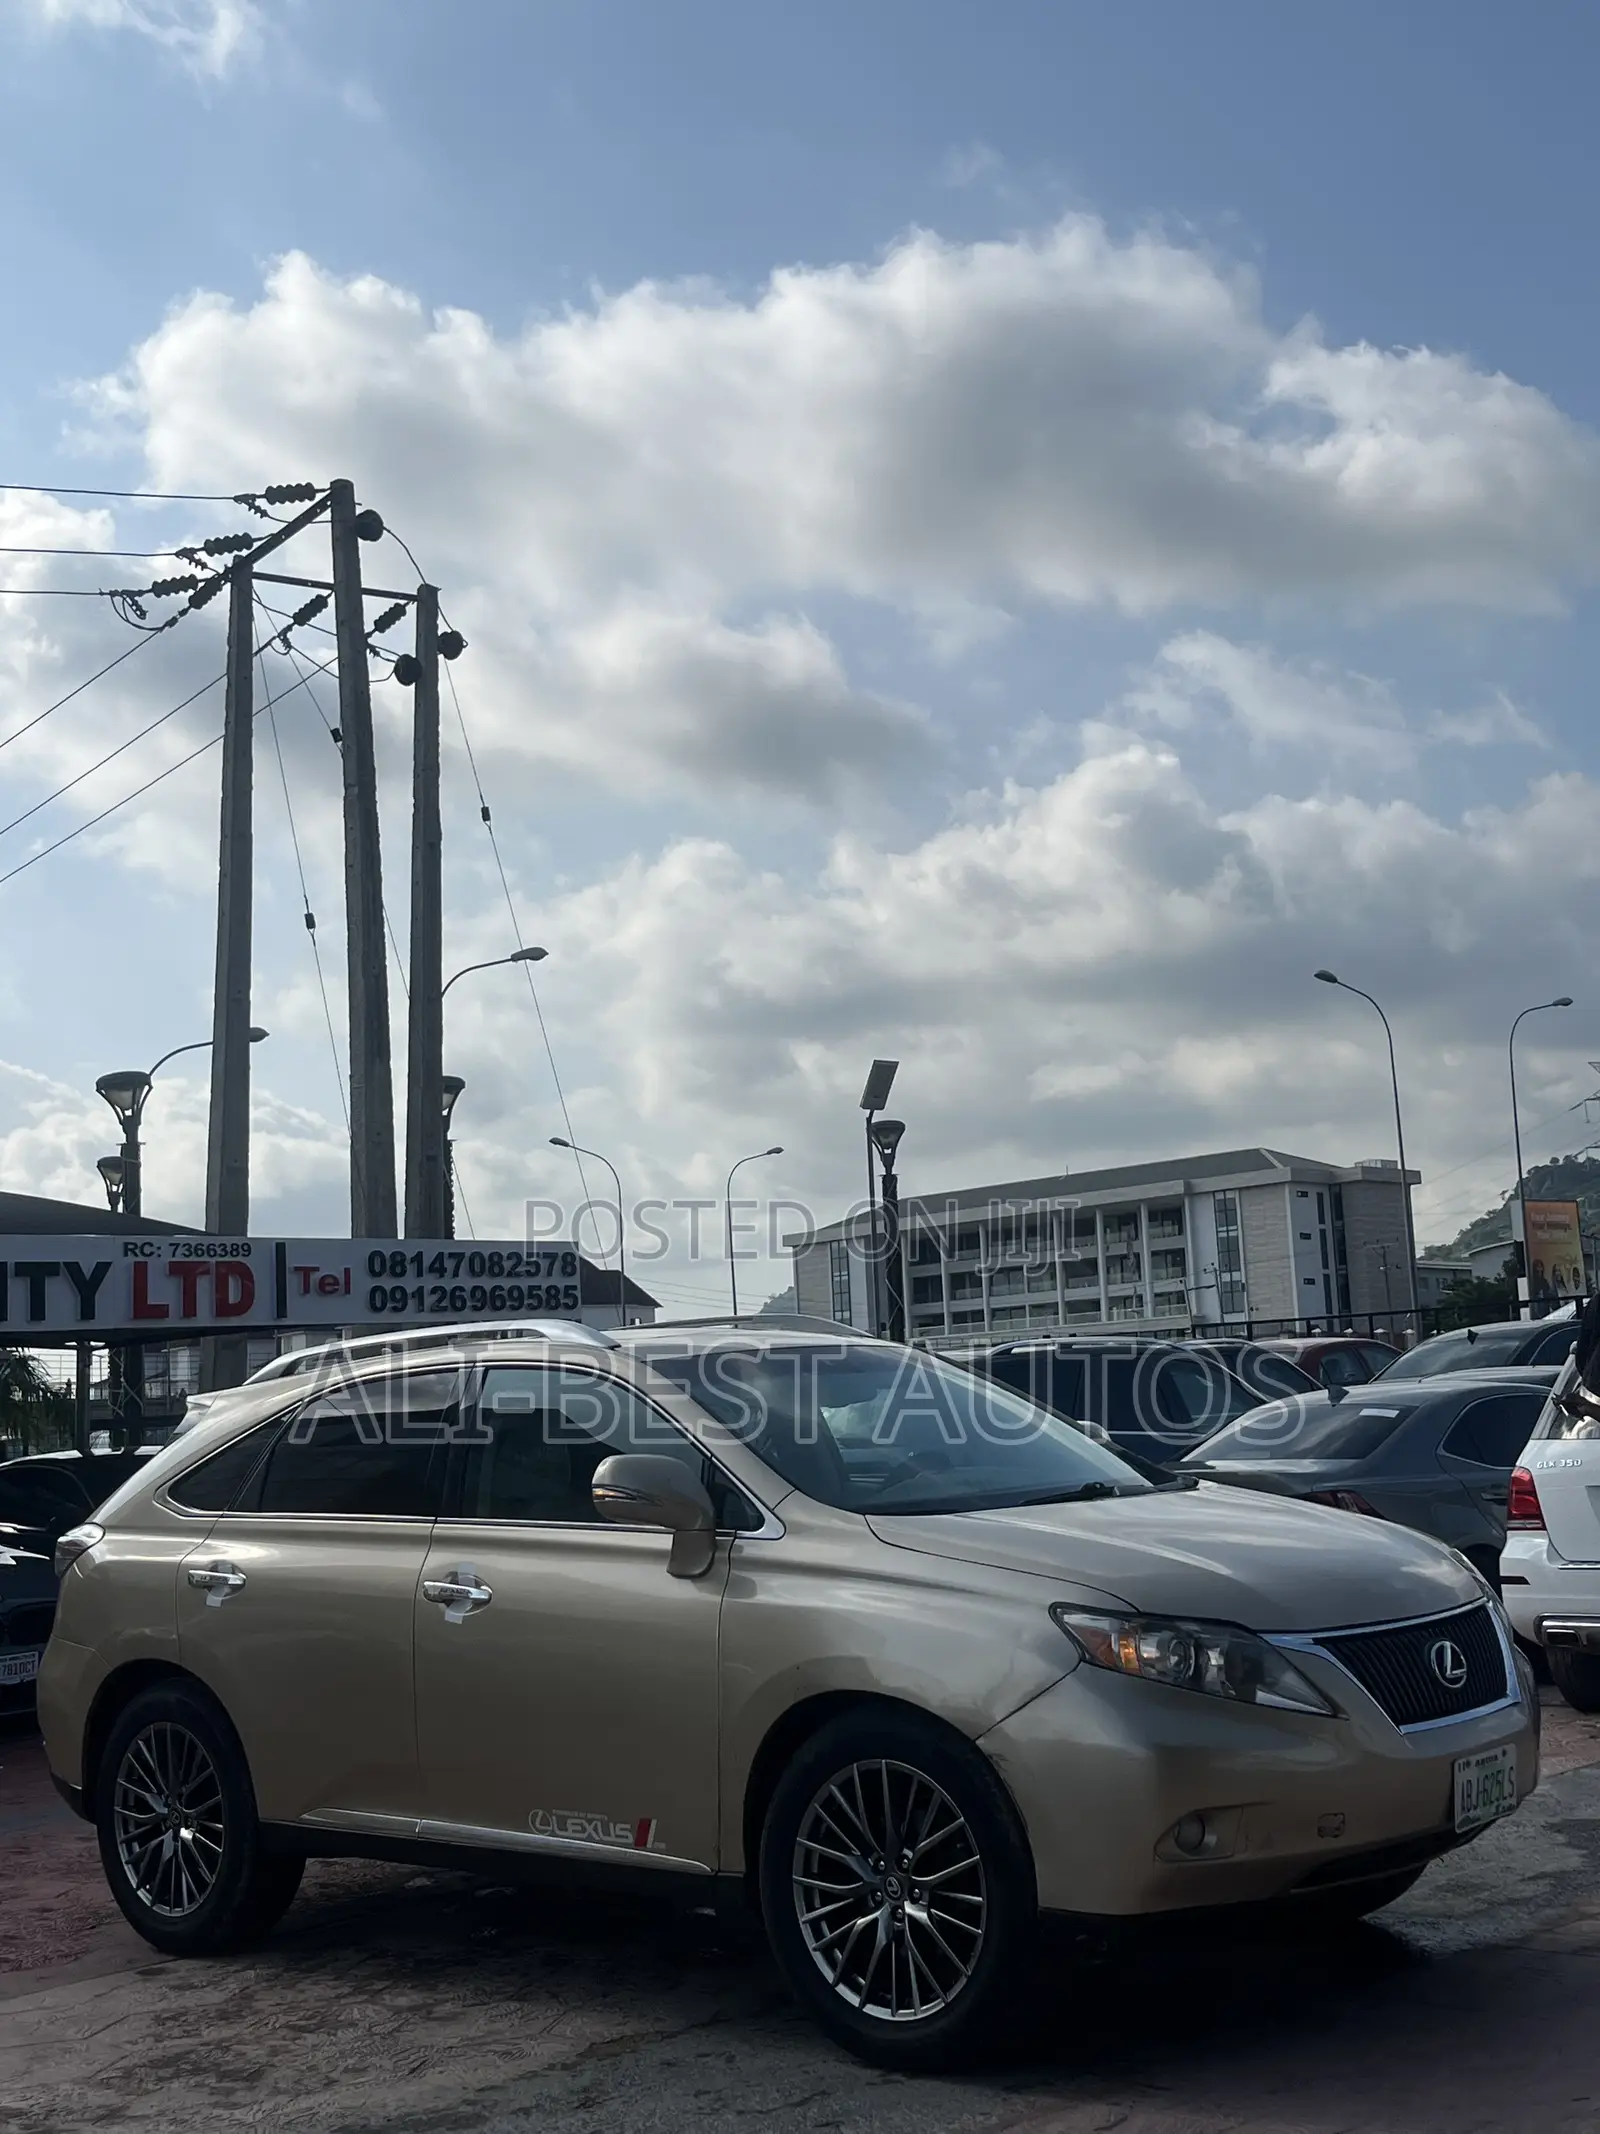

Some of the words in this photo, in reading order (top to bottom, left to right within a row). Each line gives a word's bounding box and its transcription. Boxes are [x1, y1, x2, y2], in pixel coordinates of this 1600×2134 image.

[123, 1242, 162, 1257] RC:
[169, 1243, 252, 1258] 7366389
[367, 1250, 578, 1279] 08147082578
[132, 1260, 255, 1319] LTD
[293, 1265, 351, 1296] Tel
[369, 1284, 579, 1313] 09126969585
[1559, 1459, 1582, 1468] 350
[552, 1815, 634, 1844] LEXUS
